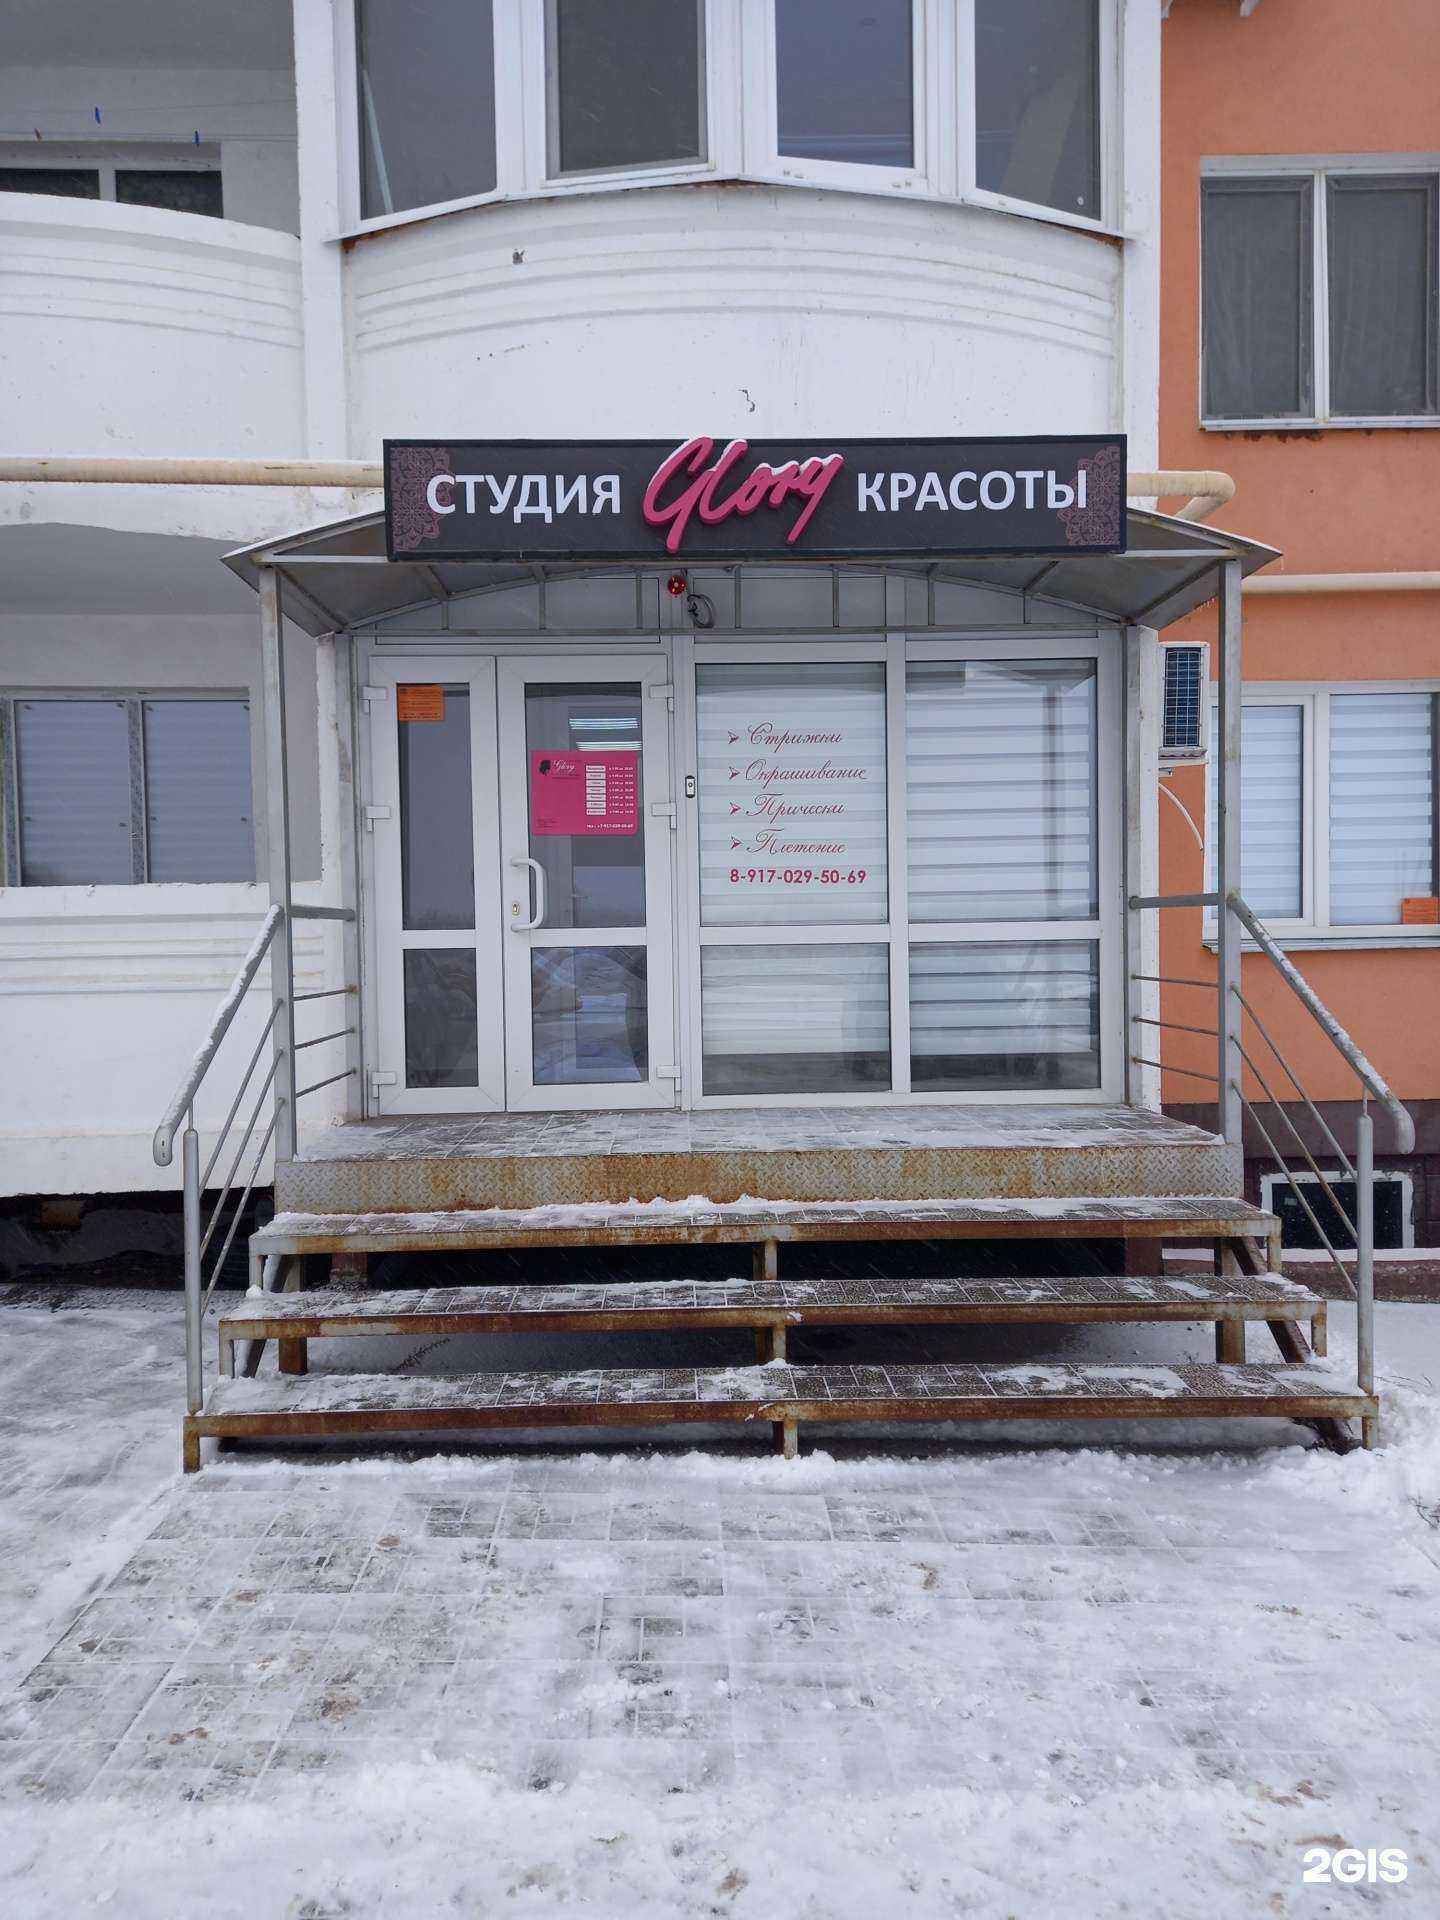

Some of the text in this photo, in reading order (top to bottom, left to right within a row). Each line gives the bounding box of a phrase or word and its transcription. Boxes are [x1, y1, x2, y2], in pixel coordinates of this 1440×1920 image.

[425, 436, 1088, 554] СТУДИЯ Glory КРАСОТЫ
[745, 759, 868, 789] Окрашивание
[746, 828, 846, 855] Плетение
[730, 868, 867, 884] 8-917-029-50-69
